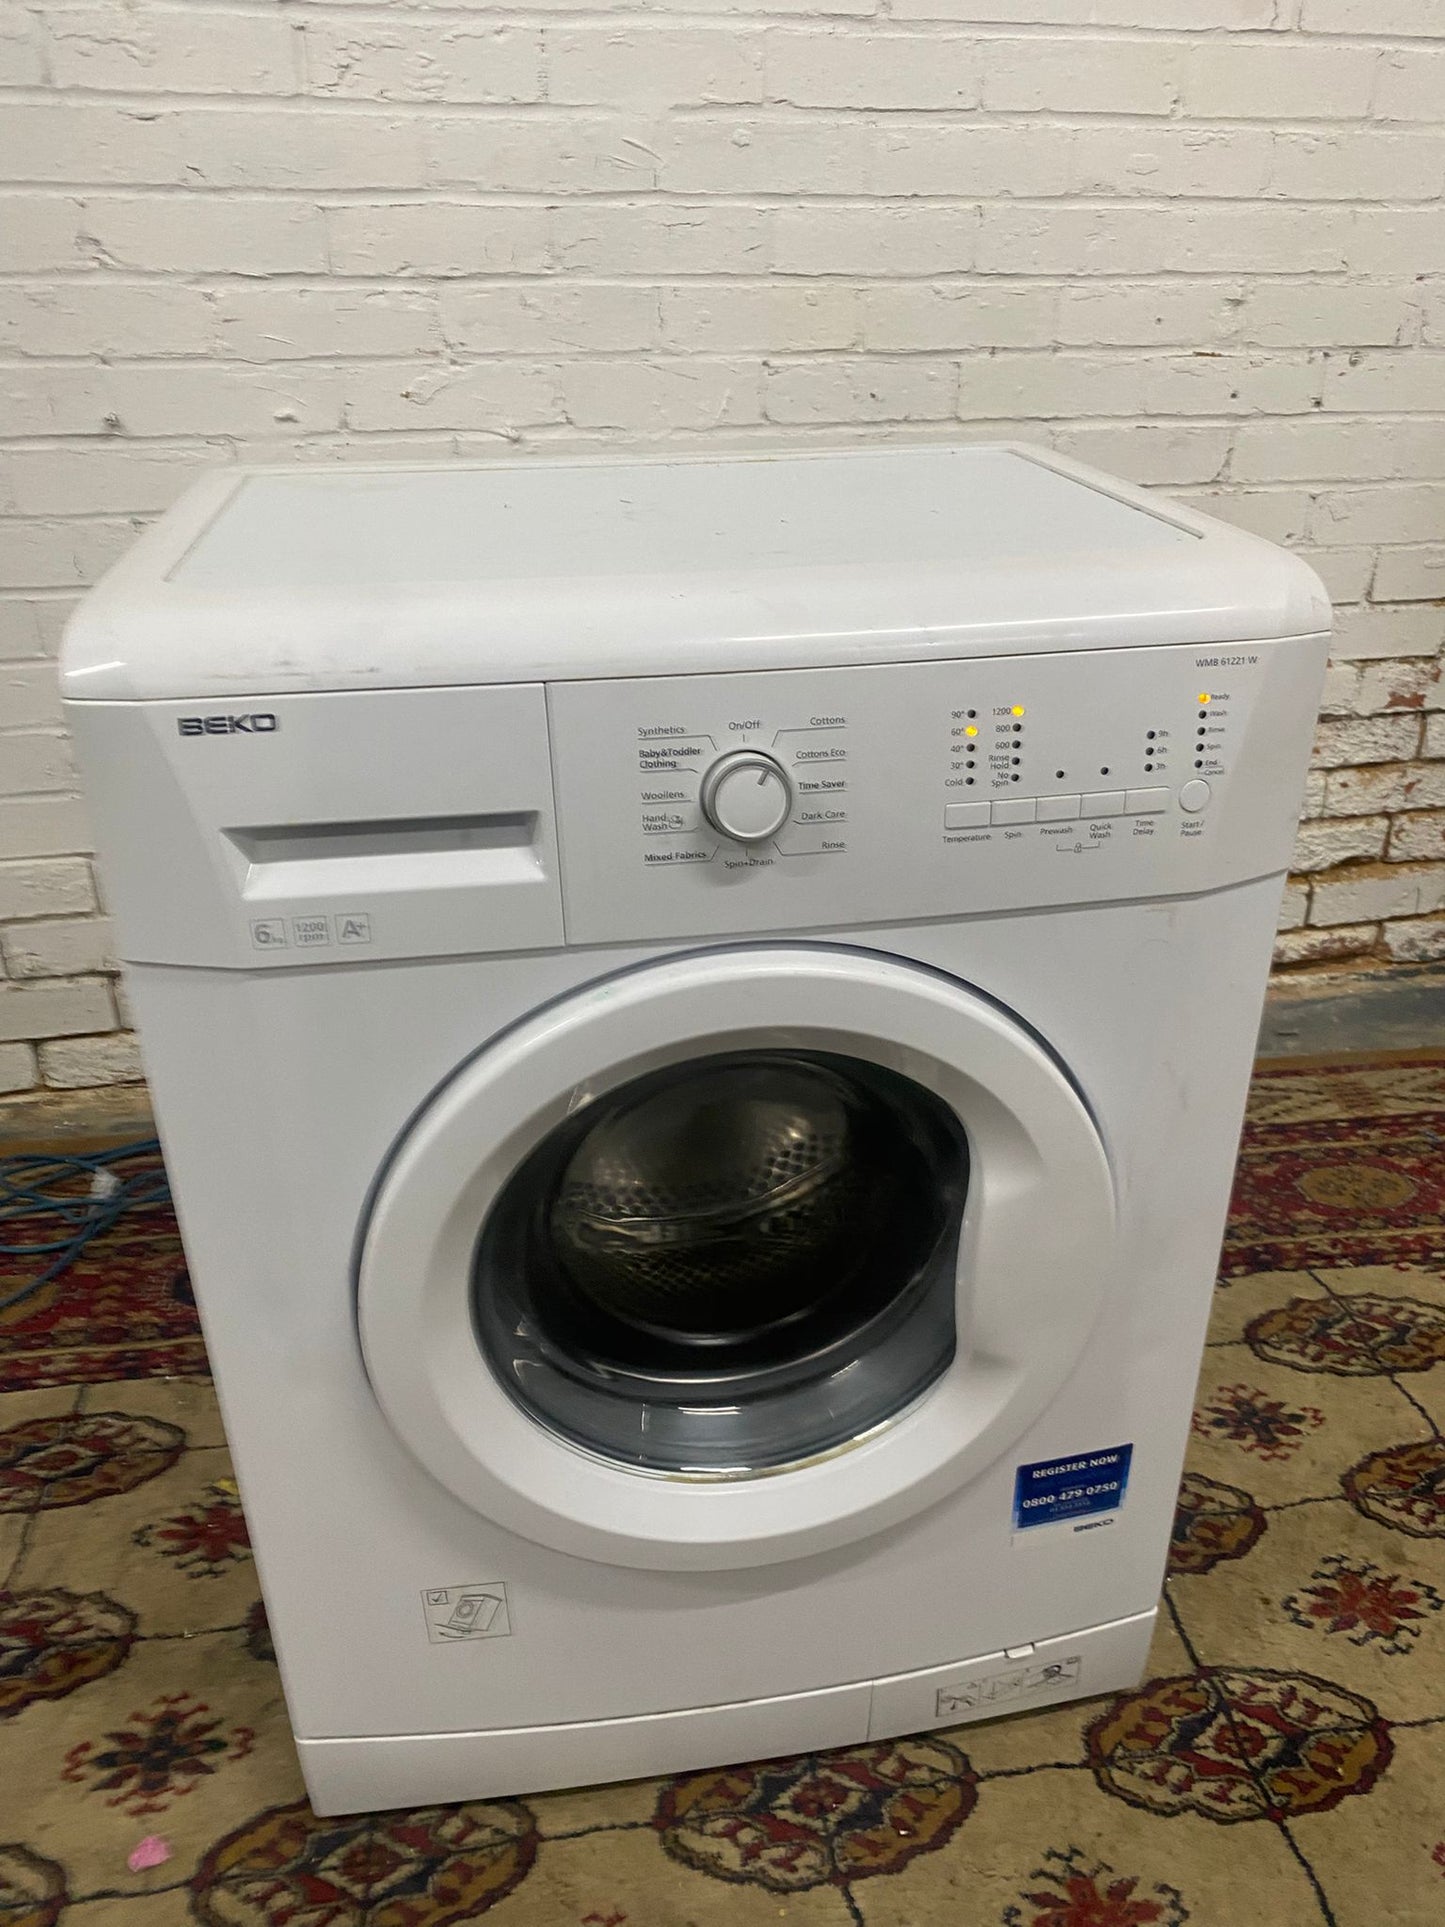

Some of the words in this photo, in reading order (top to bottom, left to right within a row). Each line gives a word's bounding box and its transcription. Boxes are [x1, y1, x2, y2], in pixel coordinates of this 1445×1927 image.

[1196, 658, 1219, 667] WMB
[1221, 657, 1246, 666] 61221
[1248, 656, 1258, 664] W
[992, 707, 1011, 716] 1200
[177, 713, 278, 736] BEKO
[728, 720, 761, 730] On/Off
[810, 716, 845, 725] Cottons
[638, 726, 685, 736] Synthetics
[995, 724, 1010, 733] 800
[995, 741, 1010, 750] 600
[1157, 746, 1167, 754] 6h
[639, 747, 701, 759] Baby&Toddler
[796, 751, 829, 760] Cottons
[989, 754, 1010, 762] Rinse
[640, 760, 677, 769] Clothing
[990, 762, 1009, 770] Hold
[1156, 762, 1166, 770] 3h
[799, 782, 820, 790] Time
[822, 780, 845, 788] Saver
[944, 778, 963, 787] Cold
[991, 779, 1009, 788] Spin
[641, 791, 684, 800] Woollens
[642, 814, 666, 823] Hand
[801, 811, 822, 820] Dark
[825, 810, 845, 818] Care
[643, 823, 668, 832] Wash
[1090, 823, 1112, 832] Quick
[1133, 828, 1154, 836] Delay
[1004, 831, 1022, 840] Spin
[1180, 829, 1202, 837] Pause
[942, 833, 992, 844] Temperature
[822, 841, 845, 849] Rinse
[644, 852, 673, 862] Mixed
[675, 851, 706, 861] Fabrics
[296, 921, 325, 933] 1200
[1032, 1461, 1087, 1479] REGISTER
[1089, 1454, 1118, 1467] NOW
[1022, 1495, 1055, 1508] 0800
[1059, 1489, 1083, 1501] 479
[1086, 1481, 1118, 1495] 0750
[1073, 1518, 1114, 1532] BEKO
